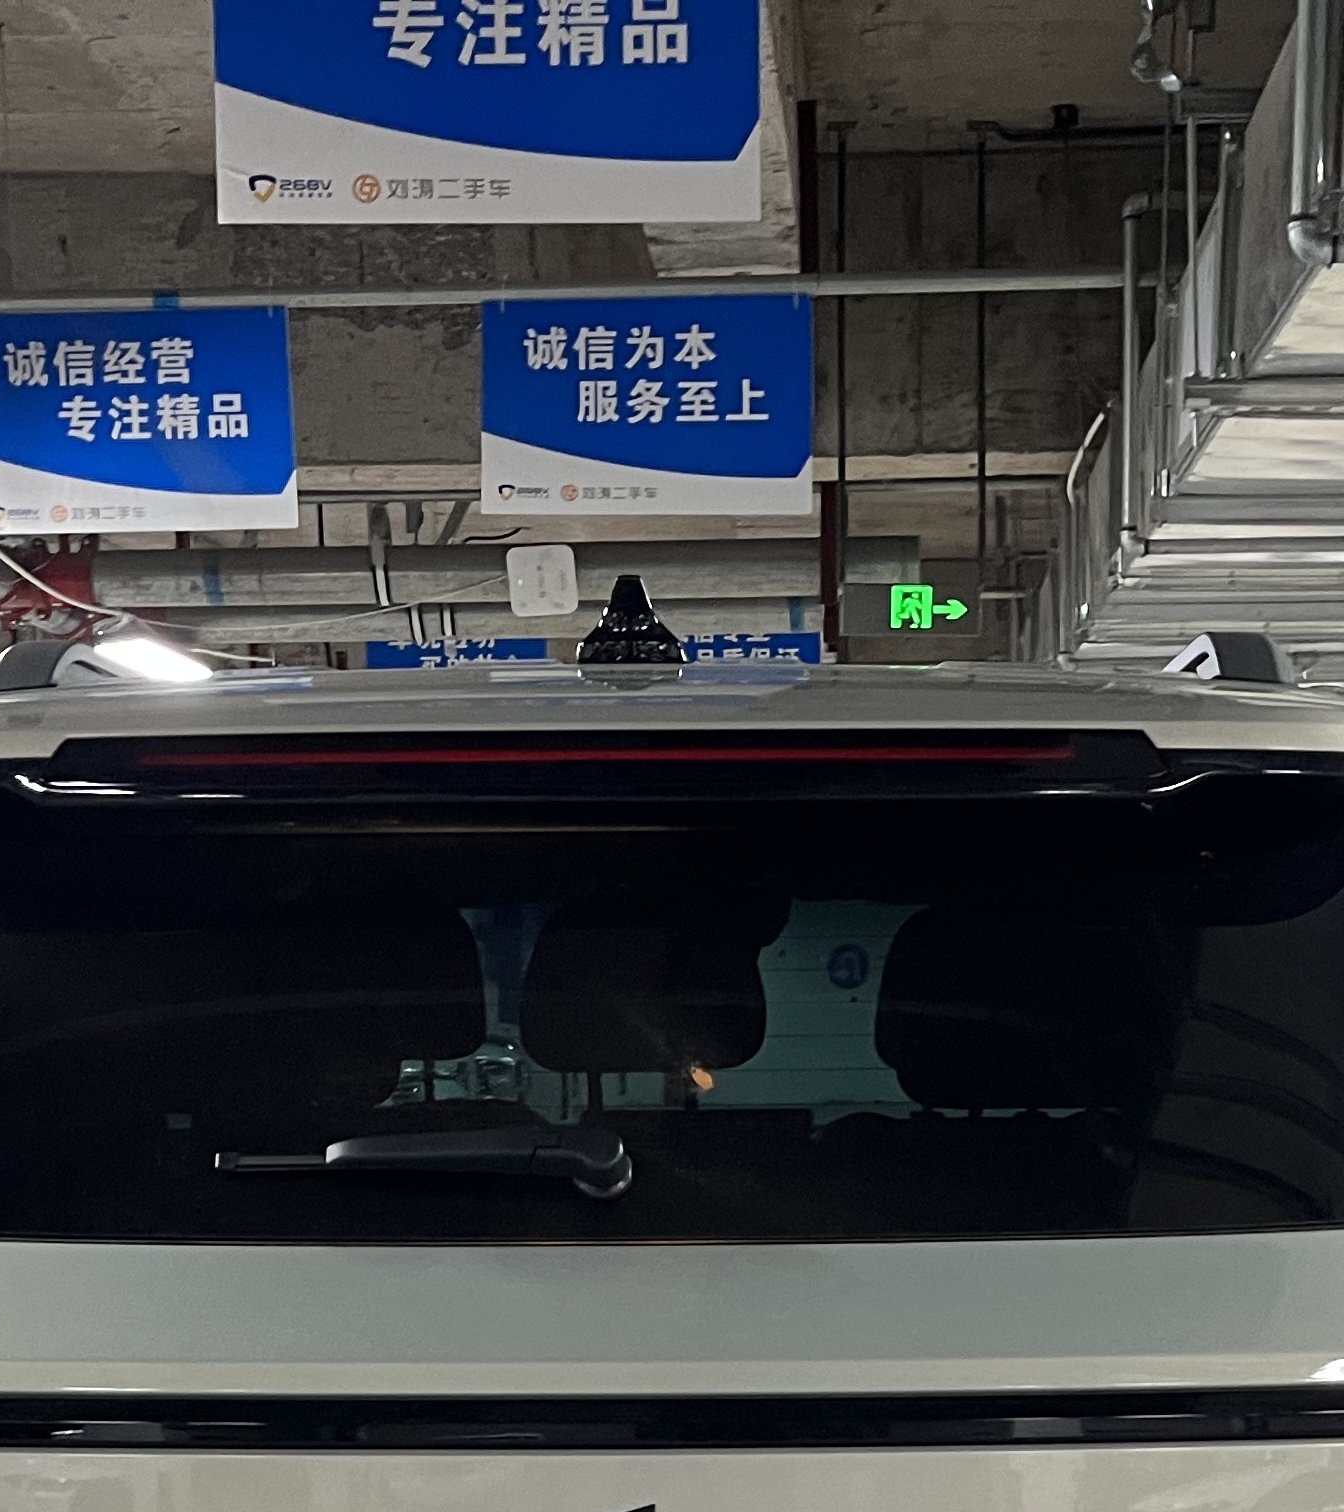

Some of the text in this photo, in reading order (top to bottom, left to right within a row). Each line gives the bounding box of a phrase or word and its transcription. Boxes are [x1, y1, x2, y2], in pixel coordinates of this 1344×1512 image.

[372, 0, 689, 68] 专注精品
[3, 337, 194, 387] 诚信经营
[523, 324, 717, 371] 诚信为本
[57, 393, 249, 443] 专注精品
[576, 378, 770, 424] 服务至上
